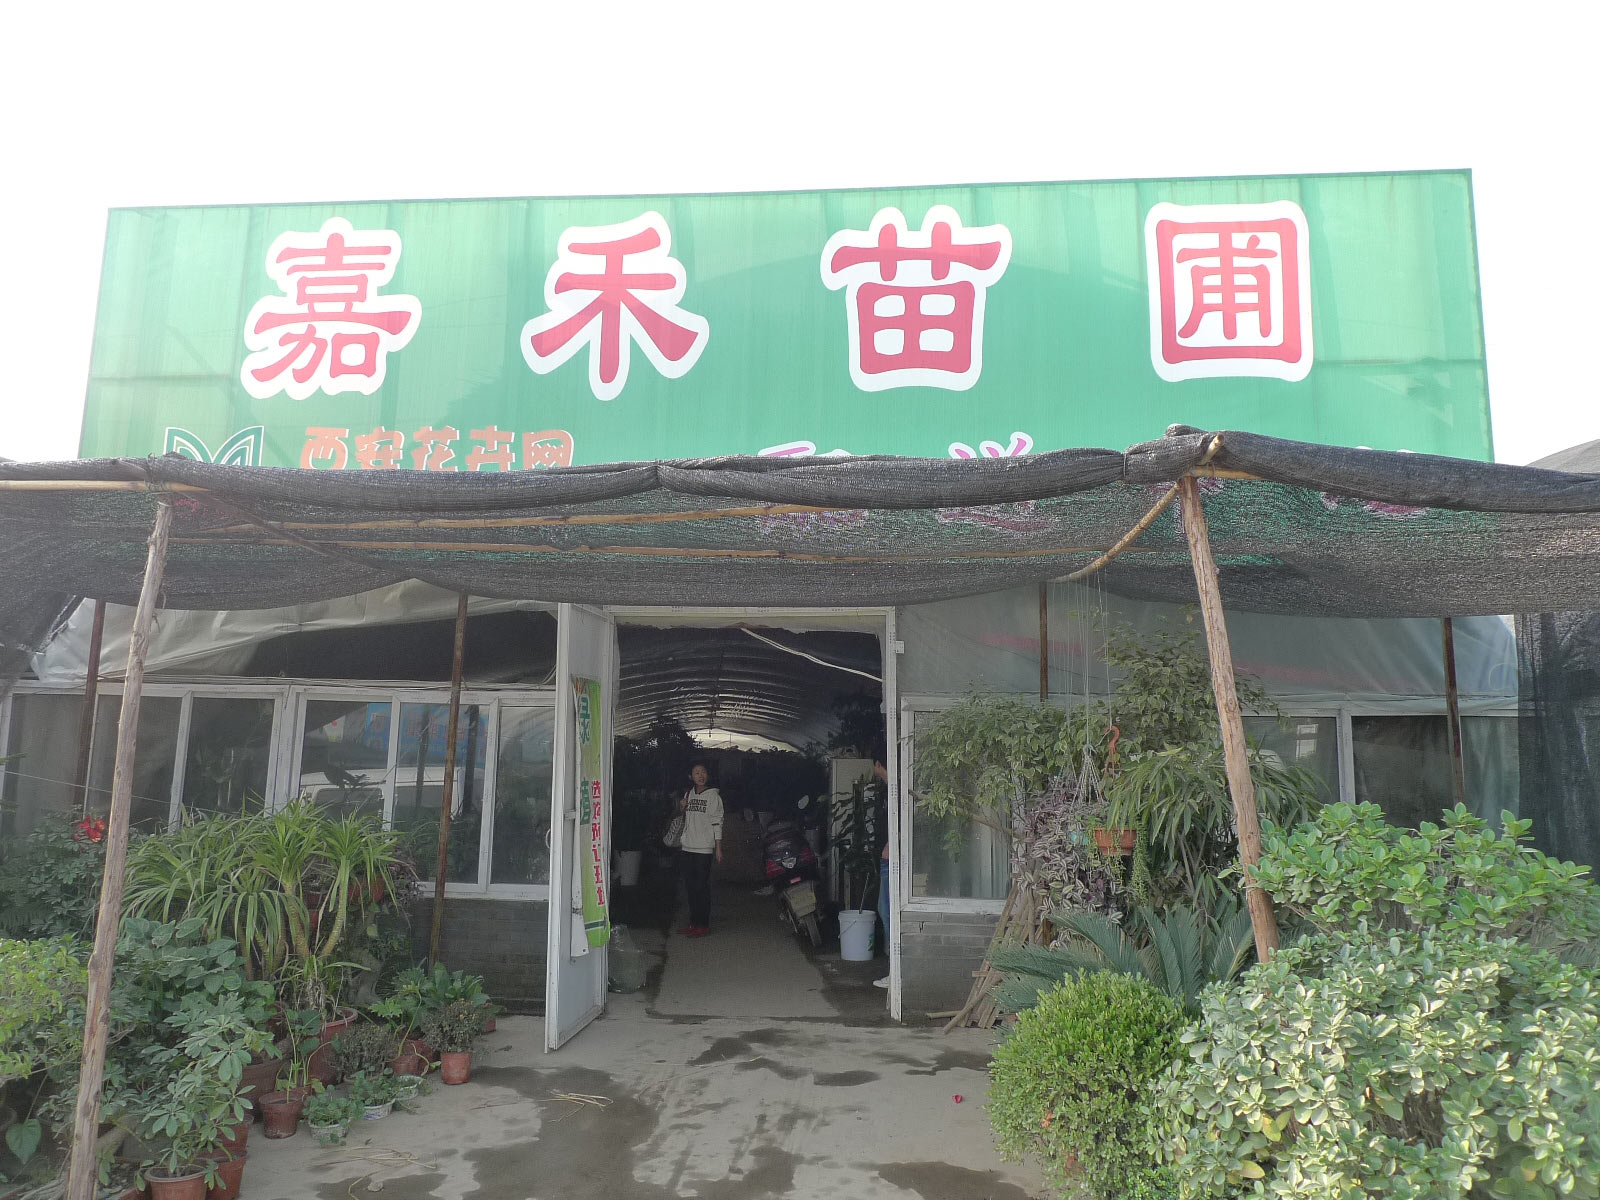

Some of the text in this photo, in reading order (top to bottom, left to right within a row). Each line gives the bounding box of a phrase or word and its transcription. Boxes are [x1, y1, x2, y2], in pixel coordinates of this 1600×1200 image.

[243, 204, 1312, 398] 嘉禾苗圃
[302, 424, 574, 471] 西安花卉网
